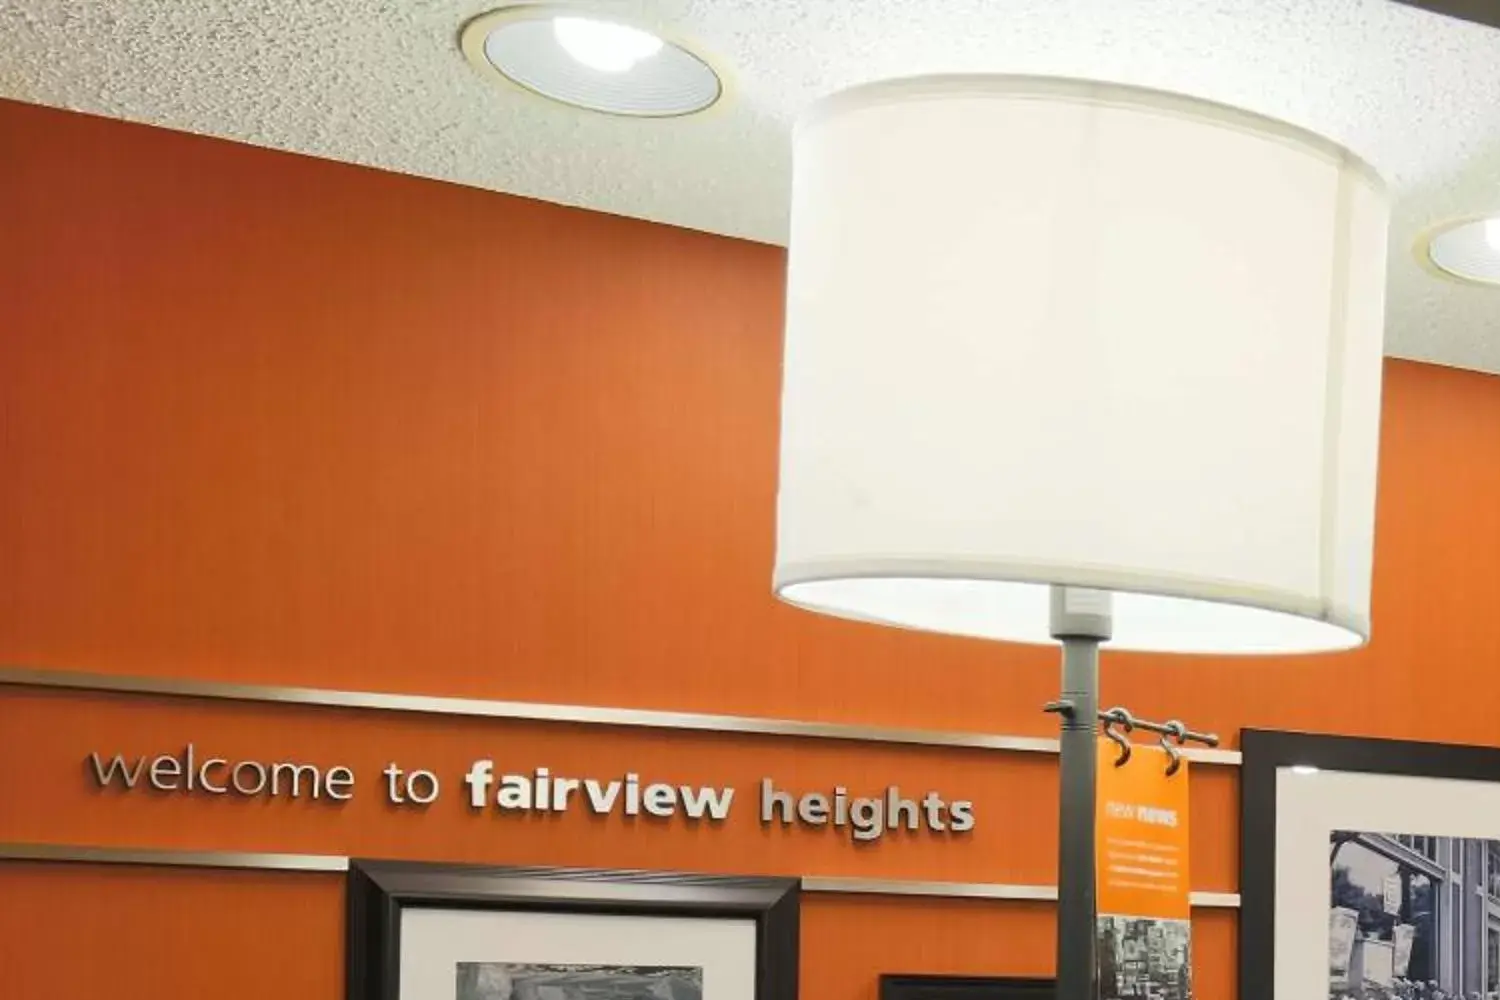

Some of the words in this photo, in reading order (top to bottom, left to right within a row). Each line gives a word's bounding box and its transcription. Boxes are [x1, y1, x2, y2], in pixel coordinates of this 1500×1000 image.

[91, 743, 355, 800] welcome
[384, 762, 440, 804] to
[465, 759, 735, 820] fairview
[760, 778, 976, 841] heights
